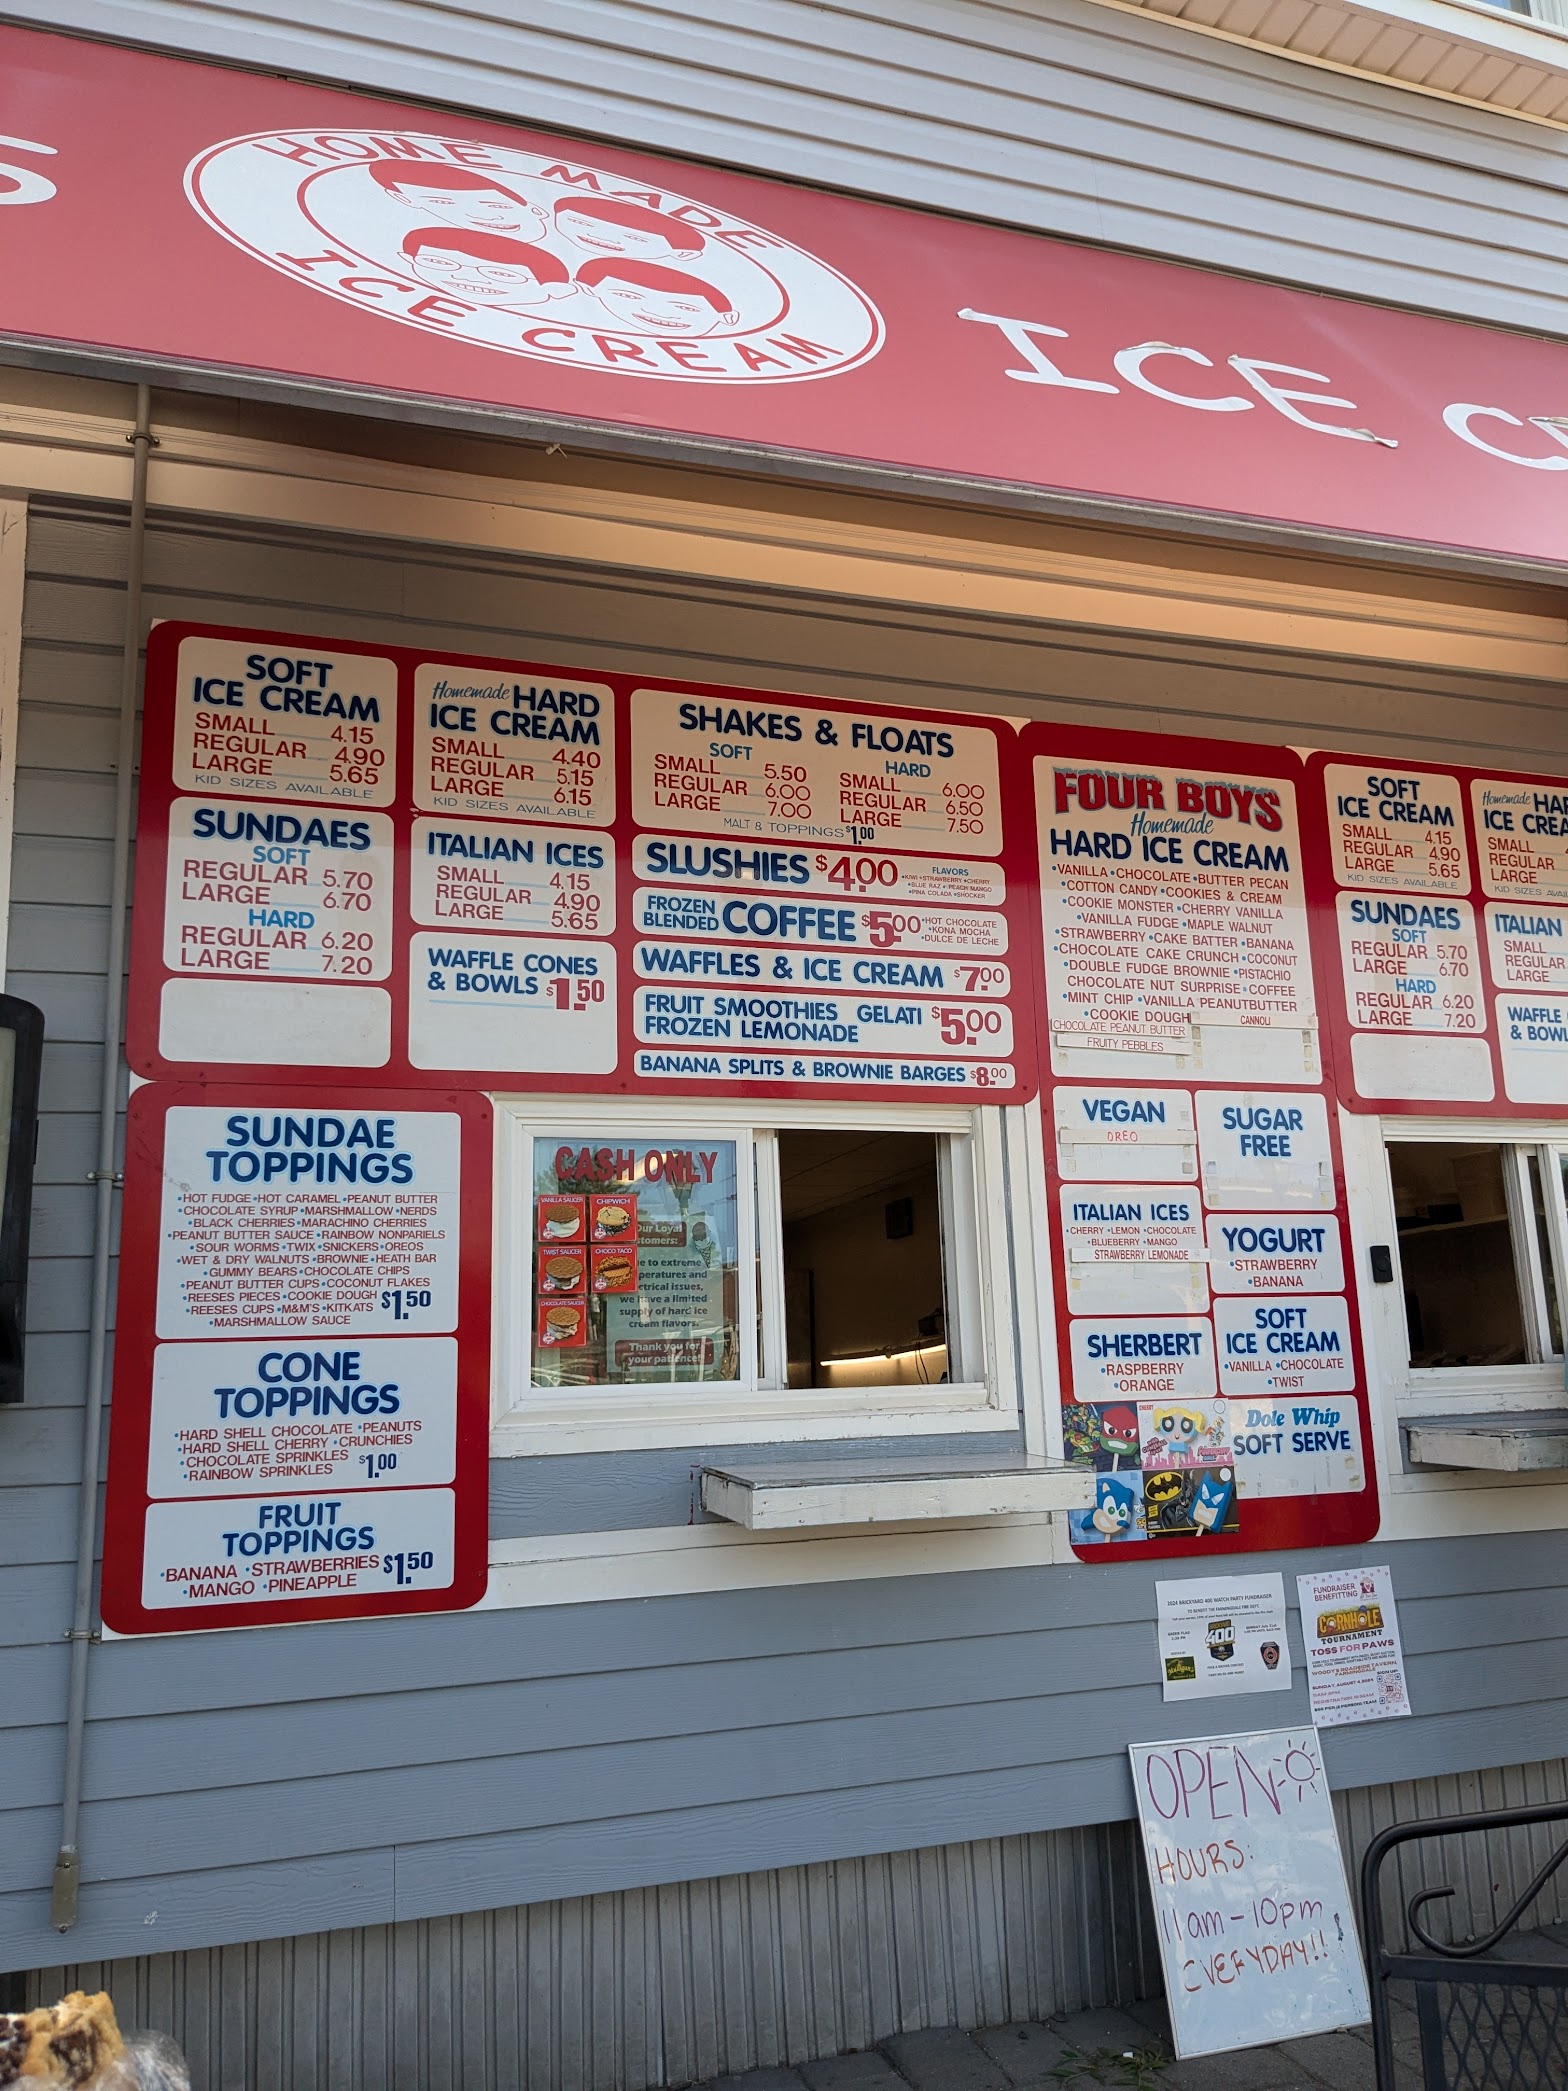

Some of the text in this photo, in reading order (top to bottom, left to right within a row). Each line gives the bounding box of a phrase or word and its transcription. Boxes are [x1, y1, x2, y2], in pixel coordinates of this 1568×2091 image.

[251, 135, 784, 252] HOME MADE
[276, 249, 844, 373] ICE CREAM
[956, 307, 1398, 448] ICE
[246, 654, 333, 687] SOFT
[194, 677, 379, 722] ICE CREAM
[432, 680, 599, 717] Homemade HARD
[195, 712, 374, 744] SMALL 4.15
[430, 704, 599, 745] ICE CREAM
[679, 704, 954, 757] SHAKES & FLOATS
[193, 732, 385, 766] REGULAR 4.90
[431, 737, 601, 768] SMALL 4.40
[709, 743, 752, 760] SOFT
[192, 753, 378, 785] LARGE 5.65
[430, 756, 593, 787] REGULAR 5.15
[654, 754, 807, 783] SMALL 5.50
[885, 761, 931, 777] HARD
[195, 774, 373, 799] KID SIZES AVAILABLE
[430, 776, 592, 806] LARGE 6.15
[839, 773, 985, 799] SMALL 6.00
[1368, 776, 1420, 800] SOFT
[1483, 791, 1531, 806] Homemade
[1053, 767, 1283, 832] FOUR BOYS
[1338, 796, 1454, 827] ICE CREAM
[193, 808, 370, 850] SUNDAES
[724, 818, 874, 845] MALT & TOPPINGS $1.00
[1131, 812, 1214, 836] Homemade
[252, 846, 310, 865] SOFT
[427, 832, 604, 869] ITALIAN ICES
[1050, 829, 1289, 872] HARD ICE CREAM
[183, 860, 373, 890] REGULAR 5.70
[437, 865, 590, 890] SMALL 4.15
[647, 842, 898, 892] SLUSHIES $4.00
[932, 867, 969, 876] FLAVORS
[1057, 864, 1288, 889] VANILLA CHOCOLATE BUTTER PECAN
[182, 882, 372, 911] LARGE 6.70
[647, 896, 715, 914] FROZEN
[248, 909, 314, 928] HARD
[644, 913, 719, 931] BLENDED
[723, 902, 921, 947] COFFEE $5.00
[925, 917, 997, 928] HOT CHOCOLATE
[1352, 900, 1460, 930] SUNDAES
[428, 948, 597, 975] WAFFLE CONES
[1352, 941, 1468, 960] REGULAR 5.70
[642, 948, 1004, 991] WAFFLES & ICE CREAM $7.00
[428, 971, 604, 1011] & BOWLS $1.50
[645, 994, 1001, 1045] FRUIT SMOOTHIES GELATI $5.00
[645, 1017, 858, 1042] FROZEN LEMONADE
[1240, 1015, 1271, 1025] CANNOLI
[641, 1056, 1007, 1087] BANANA SPLITS & BROWNIE BARGES $8.00
[1083, 1099, 1165, 1122] VEGAN
[1222, 1108, 1303, 1131] SUGAR
[226, 1115, 395, 1148] SUNDAE
[1107, 1131, 1138, 1142] OREO
[1240, 1135, 1291, 1157] FREE
[206, 1151, 413, 1184] TOPPINGS
[555, 1146, 718, 1183] CASH ONLY
[183, 1194, 437, 1204] HOT FUDGE HOT CARAMEL PEANUT BUTTER
[1073, 1204, 1189, 1221] ITALIAN ICES
[1222, 1227, 1325, 1253] YOGURT
[1094, 1250, 1188, 1260] STRAWBERRY LEMONADE
[1235, 1259, 1318, 1271] STRAWBERRY
[1253, 1276, 1303, 1287] BANANA
[382, 1290, 431, 1320] $1.50
[1255, 1308, 1306, 1329] SOFT
[1088, 1333, 1201, 1357] SHERBERT
[1226, 1332, 1340, 1354] ICE CREAM
[258, 1352, 360, 1383] CONE
[1106, 1363, 1184, 1376] RASPBERRY
[214, 1384, 400, 1418] TOPPINGS
[1246, 1408, 1340, 1428] Dole Whip
[1233, 1433, 1283, 1455] SOFT
[1292, 1430, 1350, 1452] SERVE
[359, 1454, 397, 1478] $1.00
[259, 1502, 341, 1528] FRUIT
[223, 1526, 374, 1557] TOPPINGS
[166, 1552, 433, 1585] BANANA STRAWBERRIES $1.50
[1313, 1583, 1355, 1593] FUNDRAISER
[1315, 1591, 1357, 1601] BENEFITTING
[1319, 1609, 1380, 1632] CORNHOLE
[1205, 1626, 1235, 1645] 400
[1311, 1639, 1394, 1656] TOSS FOR PAWS
[1321, 1630, 1382, 1644] TOURNAMENT
[1146, 1746, 1281, 1820] OPEN
[1155, 1840, 1254, 1884] HOURS:
